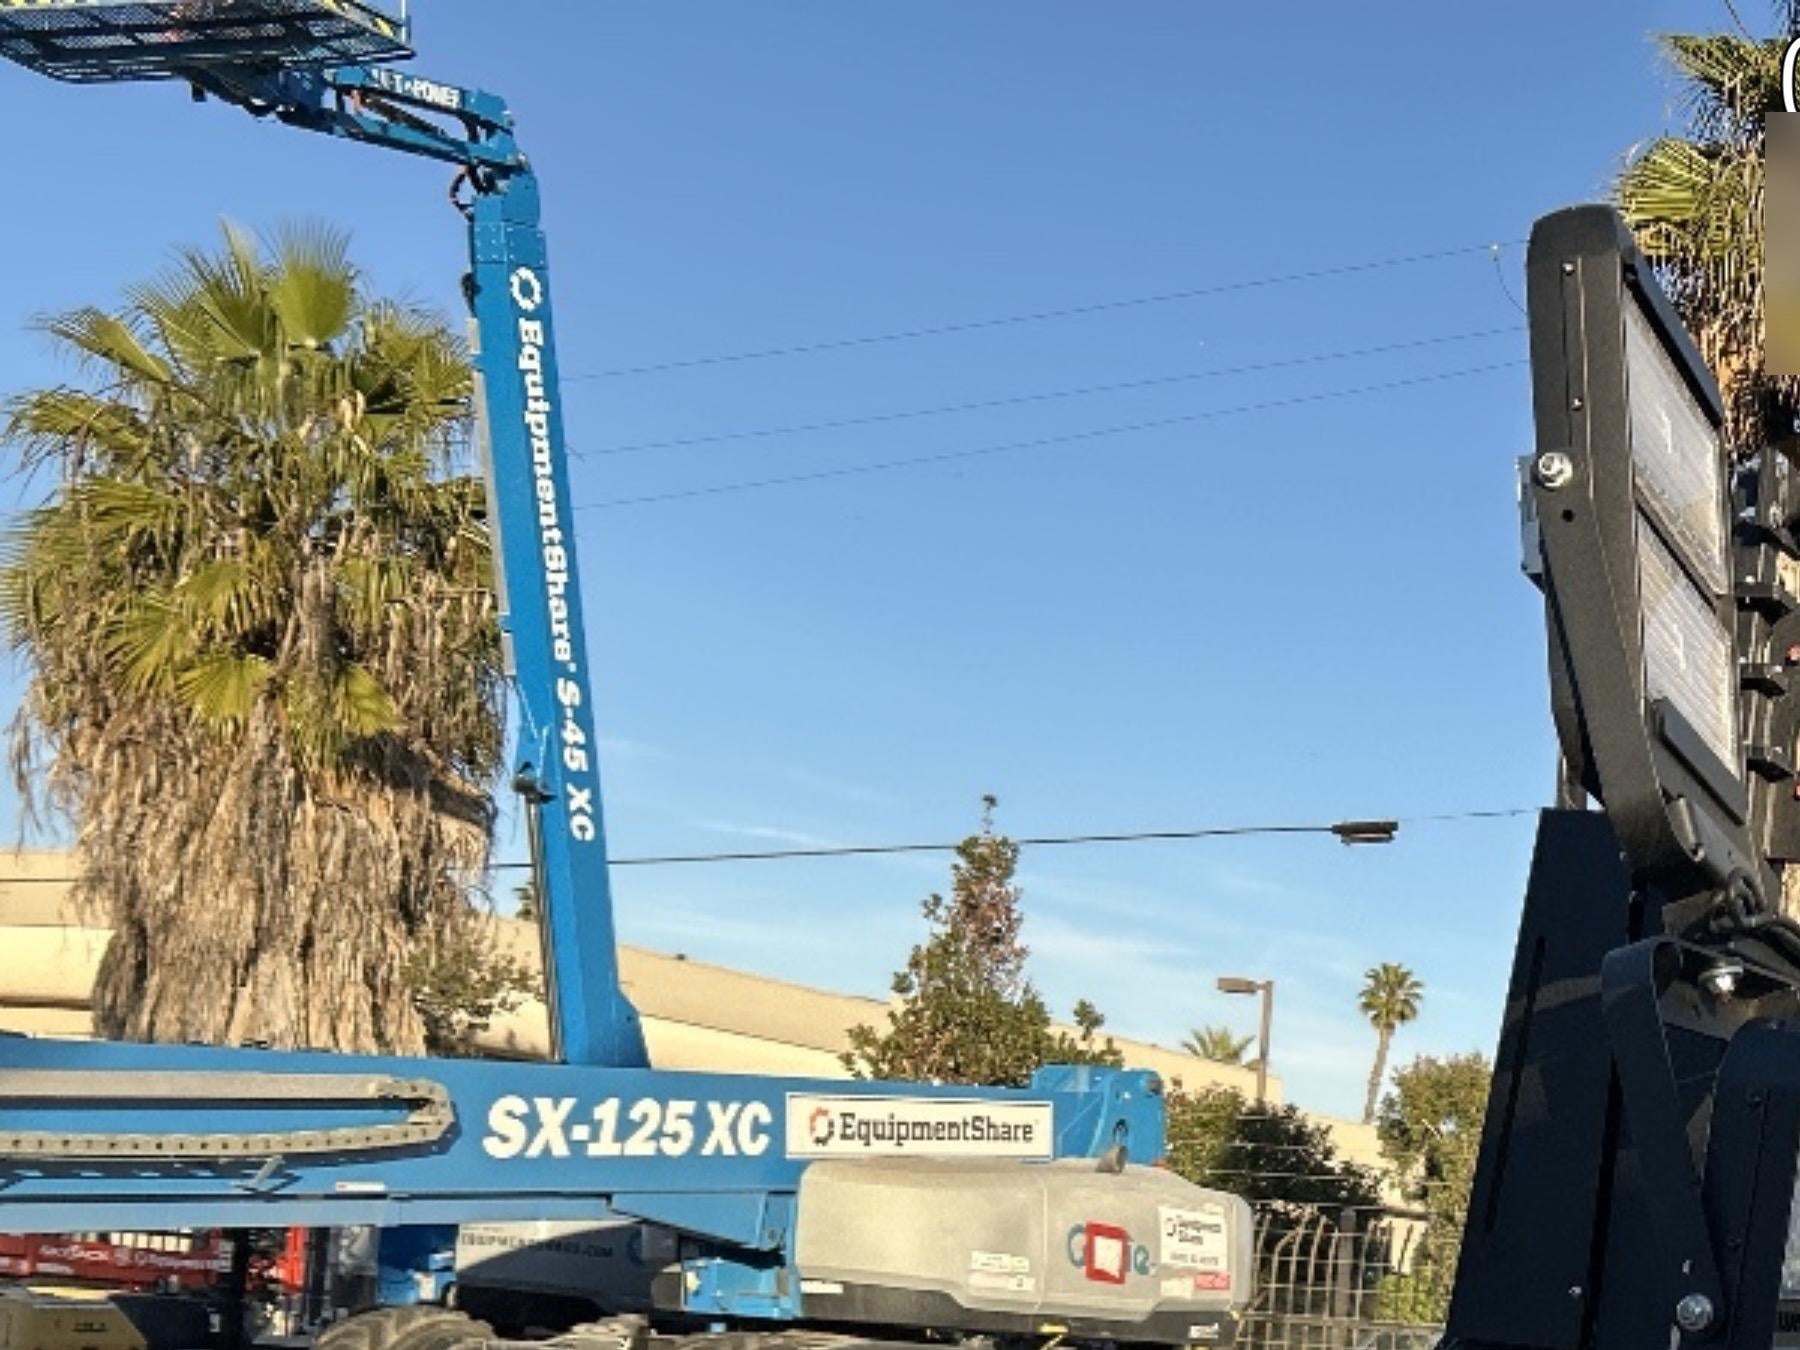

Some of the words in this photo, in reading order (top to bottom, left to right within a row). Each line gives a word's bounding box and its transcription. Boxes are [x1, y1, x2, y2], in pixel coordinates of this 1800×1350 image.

[518, 317, 571, 662] EquipmentShare
[556, 677, 589, 772] S-45
[566, 782, 595, 841] XC
[482, 1094, 697, 1159] SX-125
[700, 1100, 772, 1157] XC
[839, 1112, 1033, 1147] EquipmentShare
